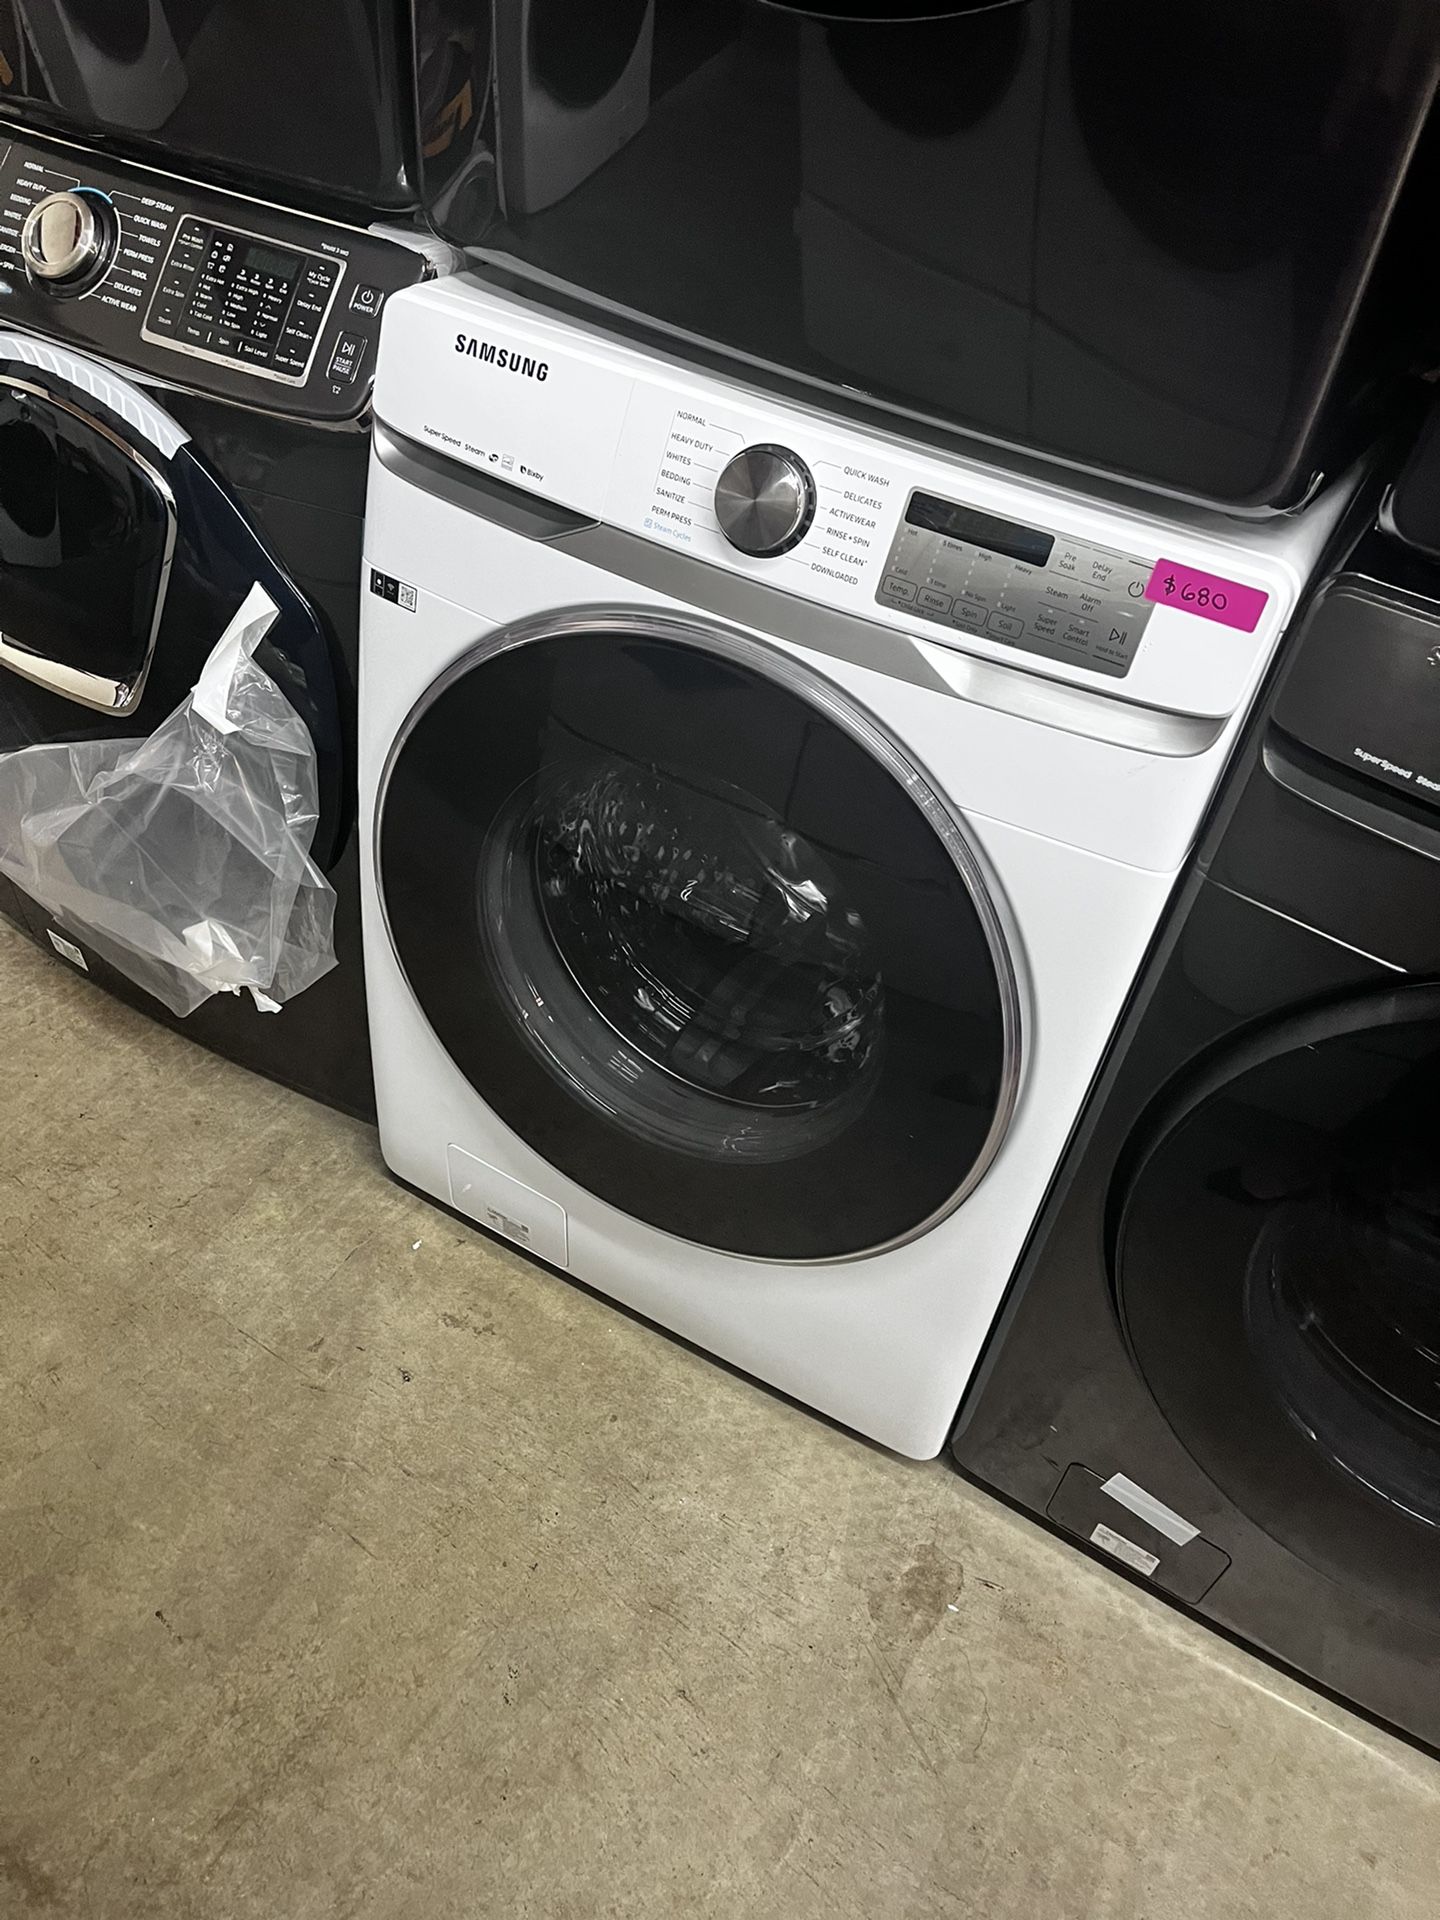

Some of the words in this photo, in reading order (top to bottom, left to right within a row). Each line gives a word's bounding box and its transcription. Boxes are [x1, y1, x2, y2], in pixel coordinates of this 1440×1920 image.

[155, 201, 175, 213] STEAM
[133, 214, 151, 226] QUICK
[150, 220, 168, 231] WASH
[0, 224, 20, 237] ANITIZE
[138, 233, 161, 248] TOWELS
[123, 248, 139, 259] PERM
[137, 252, 155, 264] PRESS
[130, 269, 147, 281] WOOL
[113, 281, 143, 297] DELICATES
[100, 295, 121, 308] ACTIVE
[119, 301, 138, 313] WEAR
[353, 302, 375, 315] POWER
[335, 356, 353, 367] START
[454, 333, 550, 383] SAMSUNG
[676, 409, 707, 427] NORMAL
[670, 431, 694, 446] HEAVY
[693, 439, 714, 453] DUTY
[464, 443, 487, 458] Steam
[665, 450, 692, 466] WHITES
[526, 468, 545, 482] Bixby
[660, 468, 692, 486] BEDDING
[843, 465, 868, 481] QUICK
[866, 473, 891, 488] WASH
[655, 486, 686, 504] SANITIZE
[843, 490, 883, 511] DELICATES
[650, 504, 672, 519] PERM
[670, 512, 693, 527] PRESS
[828, 506, 877, 529] ACTIVEWEAR
[653, 520, 673, 535] Steam
[671, 528, 693, 543] Cycles
[907, 528, 919, 537] Hot
[821, 545, 841, 558] SELF
[978, 551, 993, 563] High
[1064, 551, 1078, 563] Pre
[894, 565, 909, 576] Cold
[1013, 562, 1034, 577] Heavy
[1058, 559, 1077, 573] Soak
[1091, 560, 1114, 576] Delay
[809, 561, 859, 587] DOWNLOADED
[1091, 570, 1108, 583] End
[1045, 585, 1070, 601] Steam
[1079, 592, 1103, 607] Alarm
[1162, 573, 1228, 611] $680
[924, 594, 945, 609] Rinse
[1000, 601, 1017, 613] Light
[1081, 602, 1095, 614] Off
[960, 606, 979, 620] Spin
[1037, 612, 1058, 627] Super
[998, 618, 1014, 632] Soil
[1034, 621, 1056, 636] Speed
[1067, 623, 1091, 638] Smart
[1061, 632, 1090, 648] Control
